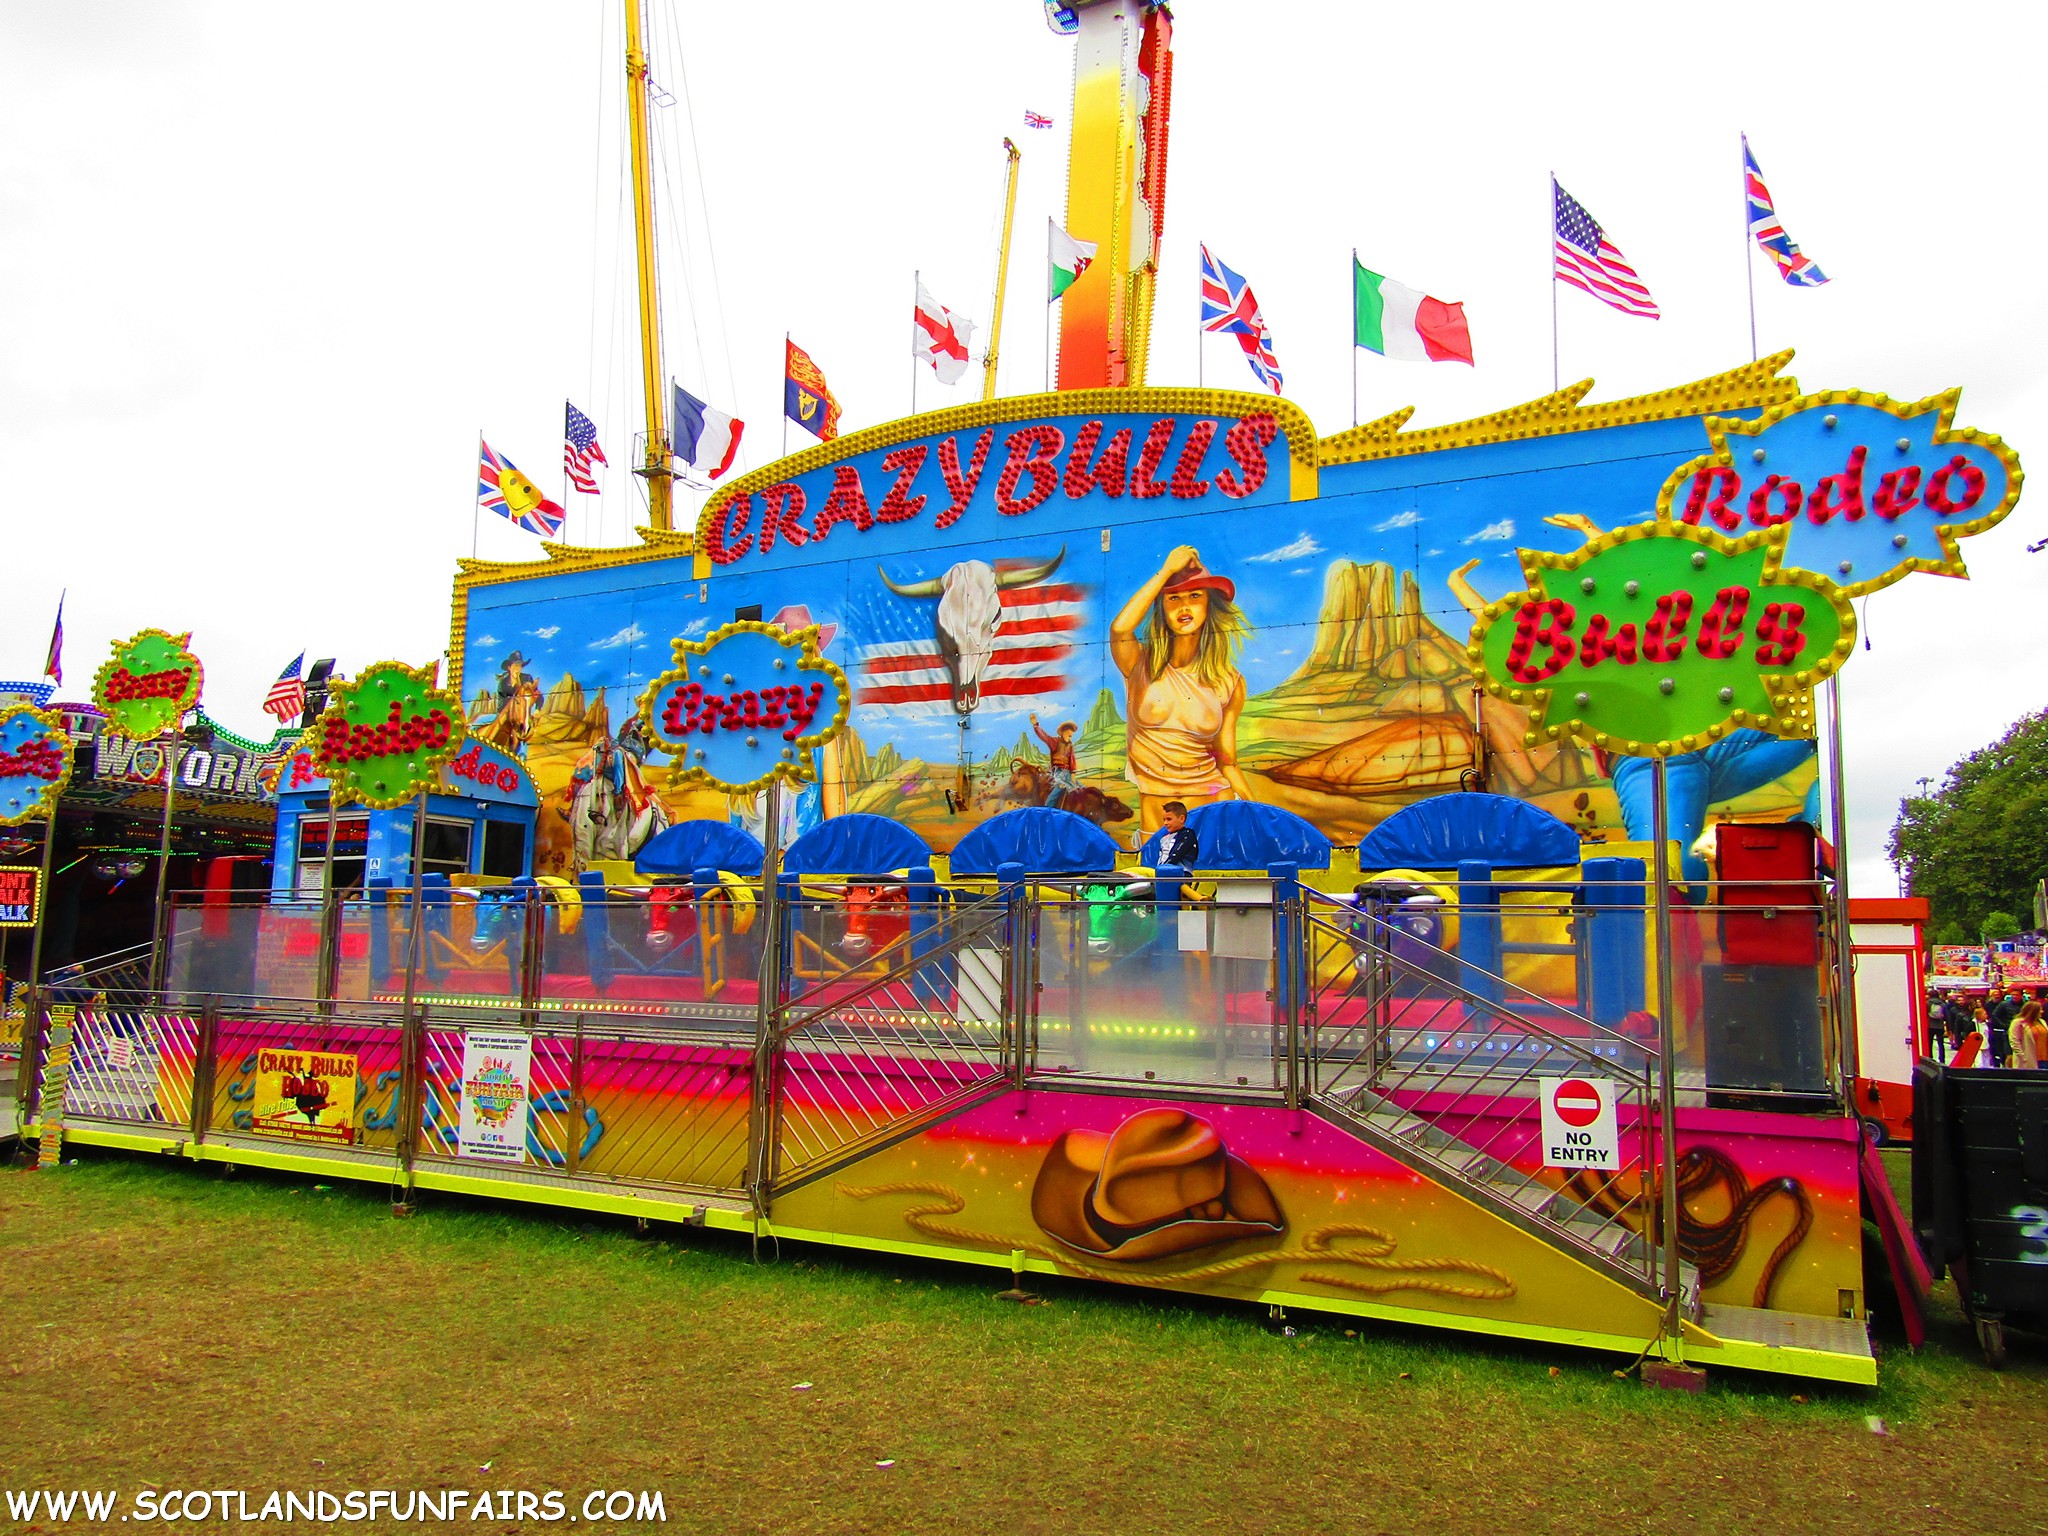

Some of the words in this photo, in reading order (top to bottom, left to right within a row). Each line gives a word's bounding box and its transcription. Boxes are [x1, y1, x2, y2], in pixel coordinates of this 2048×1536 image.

[1680, 445, 1986, 530] Rodeo
[1505, 585, 1808, 684] Bulls
[318, 700, 451, 764] Rodeo
[662, 682, 824, 742] Crazy
[161, 746, 266, 793] YORK
[260, 1052, 304, 1074] CRAZY
[310, 1055, 354, 1078] BULLS
[281, 1076, 330, 1098] RODEO
[1551, 1146, 1609, 1162] ENTRY
[1566, 1132, 1592, 1146] NO
